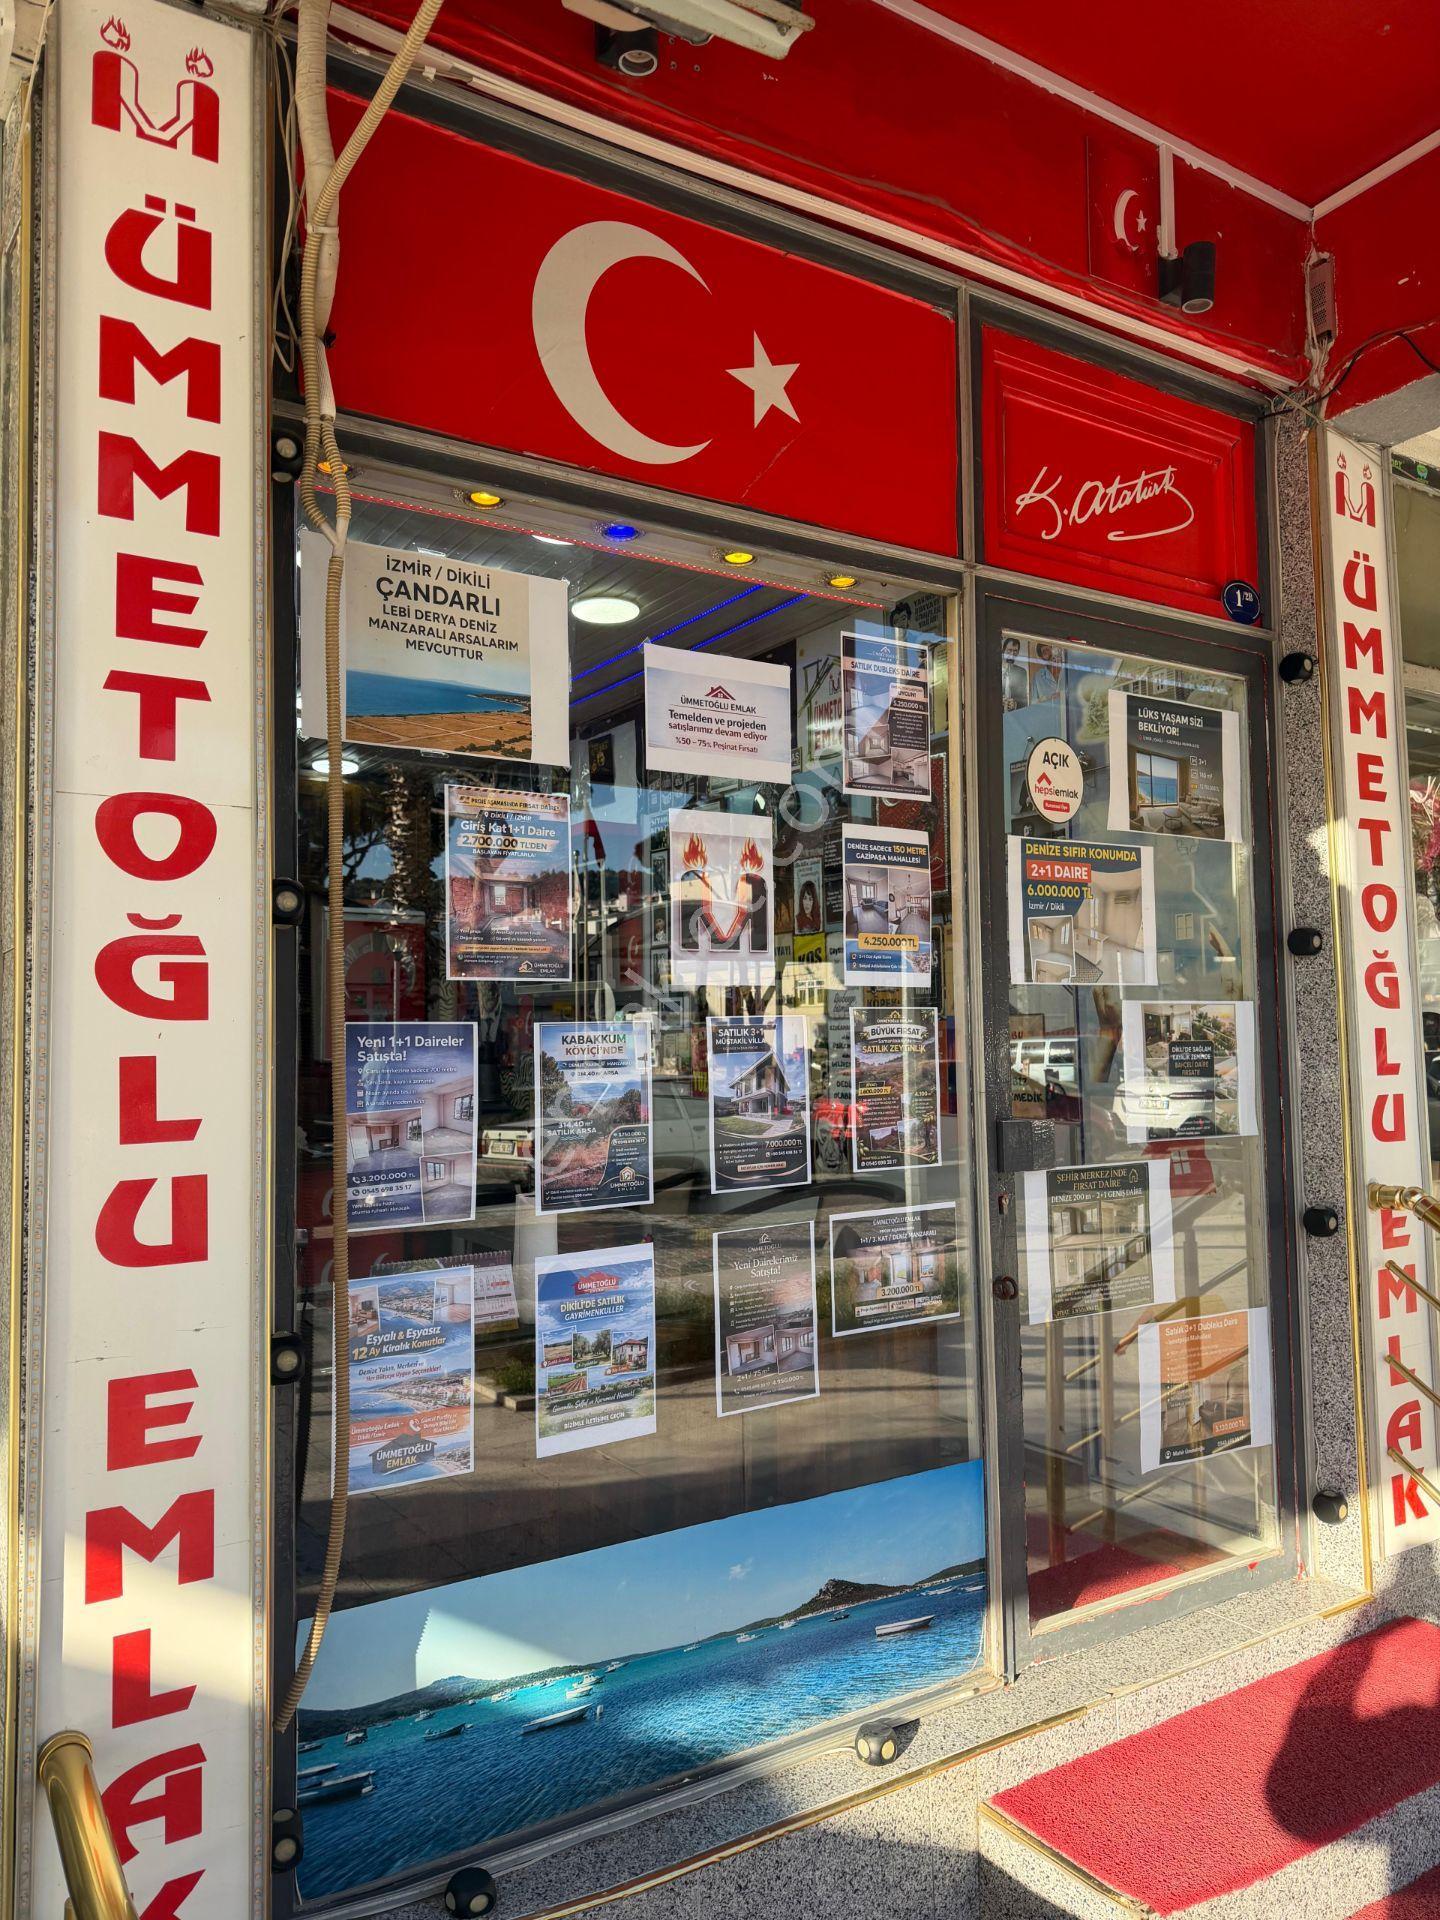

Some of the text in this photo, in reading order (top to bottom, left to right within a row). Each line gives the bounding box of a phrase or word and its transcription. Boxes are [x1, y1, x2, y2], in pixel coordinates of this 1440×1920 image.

[386, 555, 491, 589] İZMİR / DİKİLİ
[376, 576, 500, 616] ÇANDARLI
[382, 604, 497, 634] LEBİ DERYA DENİZ
[369, 617, 519, 652] MANZARALI ARSALARIM
[405, 638, 484, 661] MEVCUTTUR
[680, 695, 757, 714] ÜMMETOĞLU EMLAK
[668, 709, 767, 731] Temelden ve projeden
[1138, 708, 1203, 728] LÜKS YAŞAM SİZİ
[668, 722, 768, 742] satışlarımız devam ediyor
[1138, 721, 1180, 737] BEKLİYOR!
[675, 736, 691, 745] %50
[713, 741, 738, 753] Peşinat
[1042, 751, 1069, 769] AÇIK
[1034, 784, 1079, 800] hepsiemlak
[461, 820, 555, 837] Giriş Kat 1+1 Daire
[462, 835, 518, 848] 2.700.000
[1343, 551, 1407, 1142] ÜMMETOĞLU
[847, 842, 927, 856] DENİZE SADECE 150 METRE
[1026, 842, 1138, 862] DENİZE SIFIR KONUMDA
[856, 852, 921, 864] GAZİPAŞA MAHALLESİ
[1031, 864, 1051, 878] 2+1
[1027, 884, 1093, 899] 6.000.000 TL
[1028, 900, 1045, 910] İzmir
[1050, 902, 1065, 912] Dikili
[864, 937, 917, 948] 4.250.000 TL
[718, 1027, 764, 1037] SATILIK 3+1
[871, 1027, 896, 1036] BÜYÜK
[357, 1035, 465, 1048] Yeni 1+1 Daireler
[561, 1034, 626, 1045] KABAKKUM
[715, 1037, 748, 1045] MÜSTAKİL
[565, 1045, 624, 1057] KÖYİÇİ'NDE
[862, 1045, 888, 1053] SATILIK
[85, 194, 221, 1920] ÜMMETOĞLU EMLA
[357, 1050, 407, 1064] Satışta!
[547, 1127, 597, 1137] SATILIK ARSA
[765, 1139, 797, 1148] 7.000.000
[361, 1172, 407, 1183] 3.200.000
[1057, 1168, 1128, 1184] ŞEHİR MERKEZİNDE
[1073, 1178, 1121, 1191] FIRSAT DAİRE
[1073, 1193, 1085, 1201] 200
[734, 1254, 798, 1271] Yeni Dairelerimiz
[750, 1265, 781, 1278] Satışta!
[577, 1279, 617, 1290] ÜMMETOĞLU
[881, 1285, 914, 1297] 3.200.000
[560, 1295, 625, 1313] DİKİLİ'DE SATILIK
[366, 1333, 397, 1345] Eşyalı
[406, 1325, 442, 1340] Eşyasız
[352, 1336, 447, 1361] 12 Ay Kiralık Konutlar
[358, 1367, 378, 1376] Denize
[384, 1422, 400, 1430] Emlak
[376, 1442, 433, 1461] ÜMMETOĞLU
[386, 1456, 418, 1469] EMLAK
